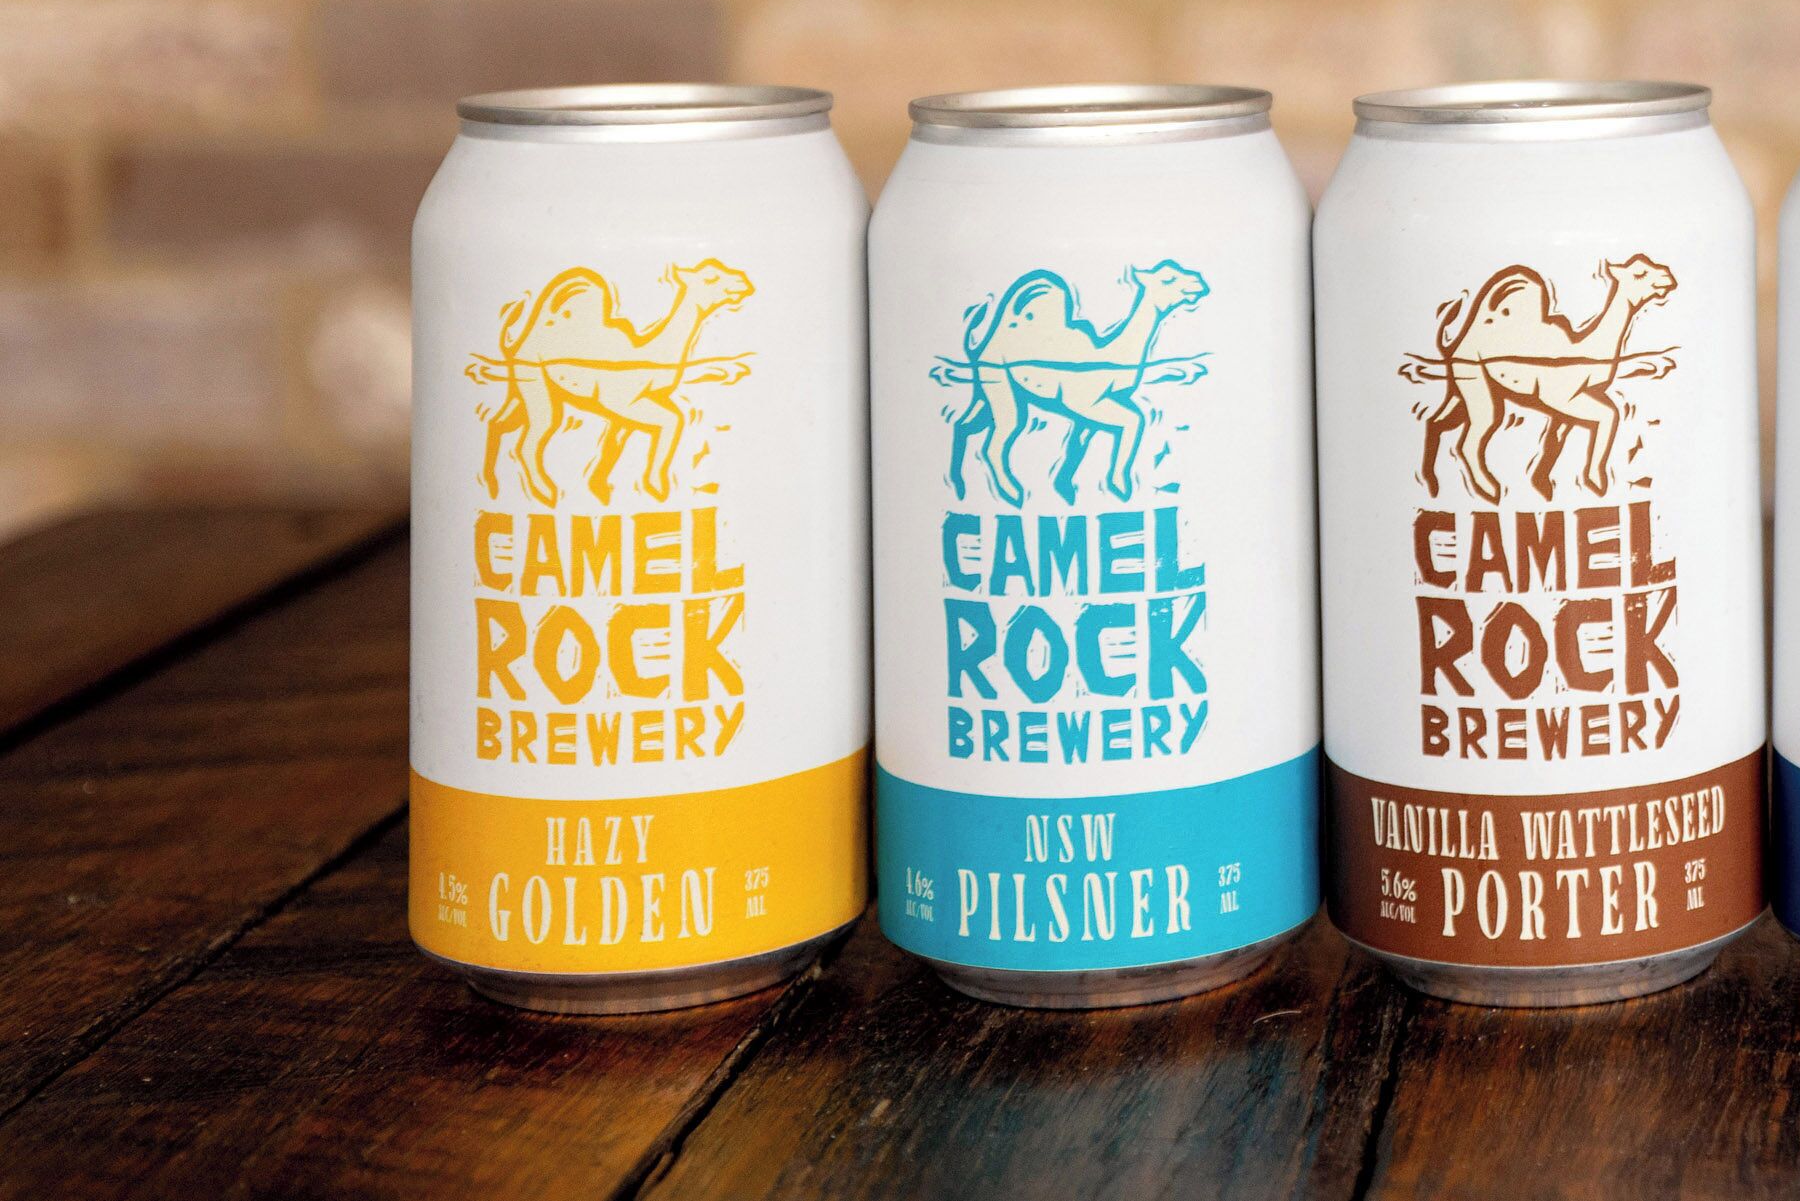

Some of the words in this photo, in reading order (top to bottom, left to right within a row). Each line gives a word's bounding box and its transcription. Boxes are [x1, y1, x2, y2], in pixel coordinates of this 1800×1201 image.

[474, 506, 745, 597] CAMEL
[942, 506, 1206, 597] CAMEL
[1414, 501, 1676, 593] CAMEL
[475, 592, 745, 705] ROCK
[943, 591, 1207, 704] ROCK
[1415, 586, 1680, 700] ROCK
[476, 701, 745, 766] BREWERY
[948, 700, 1208, 765] BREWERY
[1421, 694, 1680, 761] BREWERY
[546, 814, 655, 866] HAZY
[1024, 813, 1116, 863] NSW
[1371, 797, 1500, 861] VANILLA
[1520, 785, 1725, 861] WATTLESEED
[744, 867, 770, 889] 375
[905, 866, 934, 900] 4.6%
[1218, 862, 1241, 886] 375
[1220, 891, 1239, 914] ML
[1381, 868, 1417, 902] 5.6%
[1441, 860, 1659, 941] PORTER
[1684, 858, 1705, 883] 375
[1686, 886, 1704, 912] ML
[488, 866, 717, 945] GOLDEN
[745, 899, 767, 919] ML
[957, 864, 1192, 943] PILSNER
[1380, 900, 1416, 923] ALC/VOL
